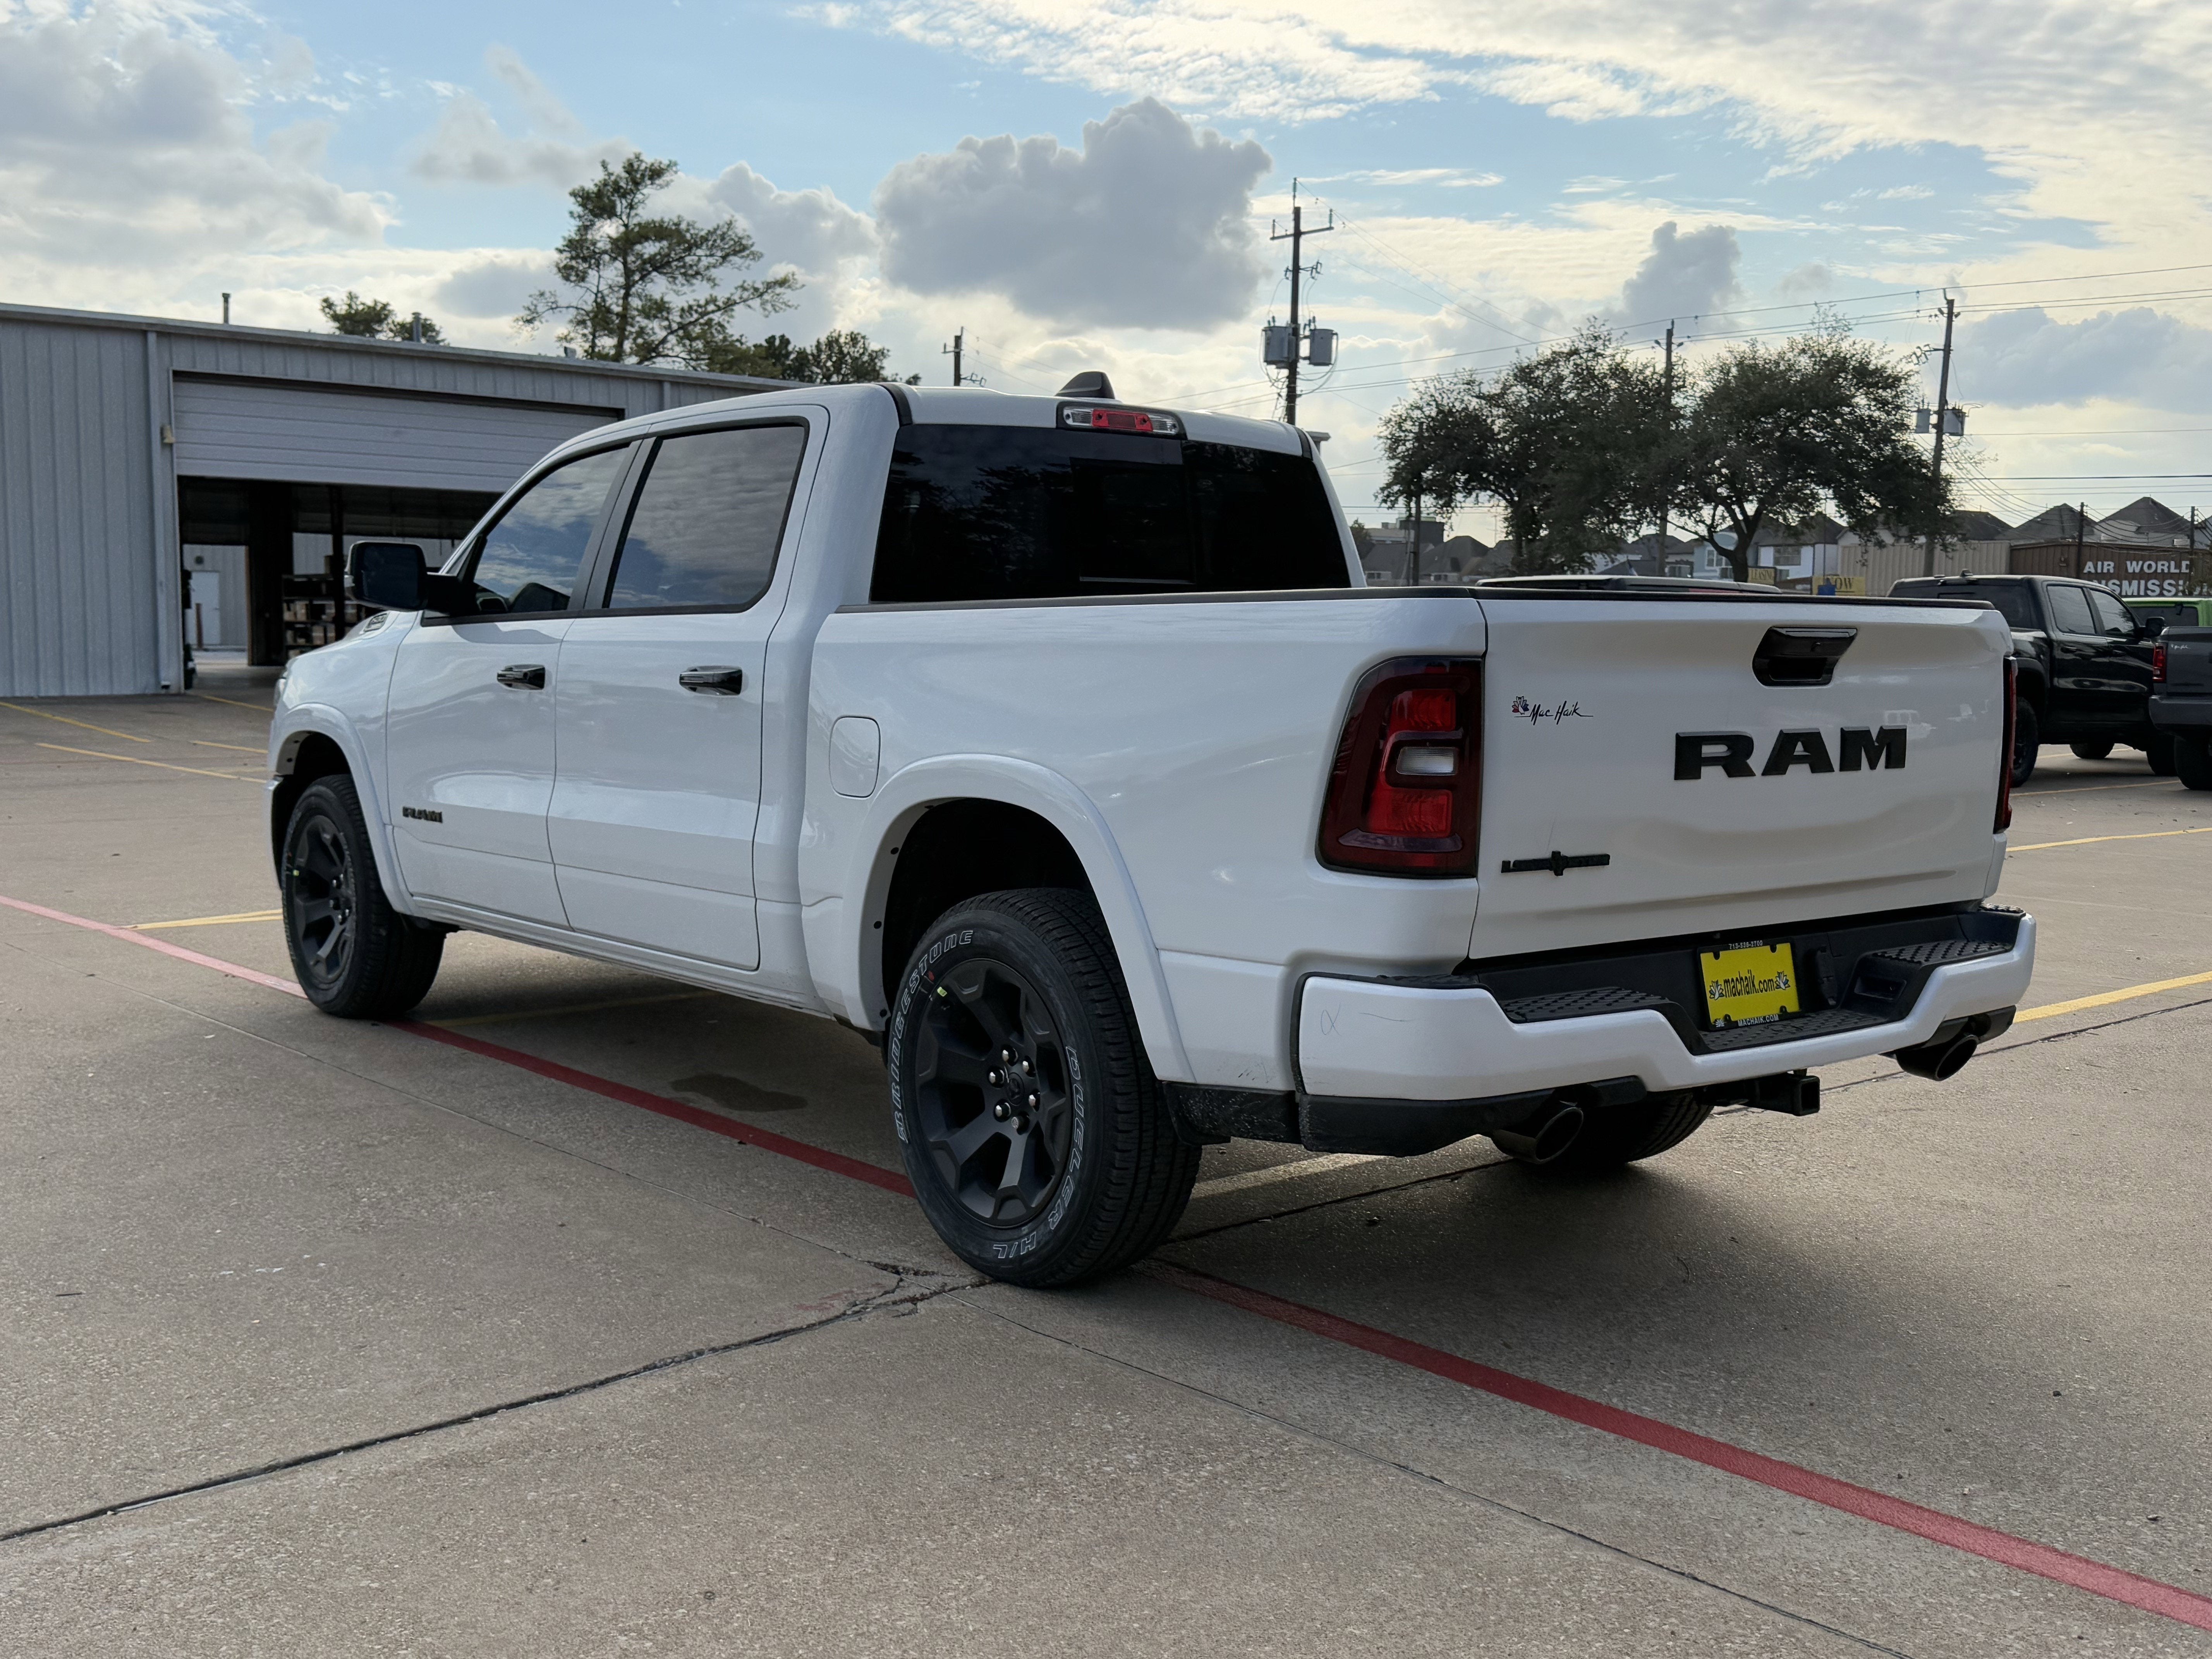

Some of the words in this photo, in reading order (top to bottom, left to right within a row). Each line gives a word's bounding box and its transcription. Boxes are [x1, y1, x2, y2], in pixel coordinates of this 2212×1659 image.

[2083, 561, 2114, 573] AIR
[1530, 704, 1554, 725] Mac
[1554, 700, 1593, 725] Haik
[1674, 725, 1907, 780] RAM
[402, 806, 443, 823] RAM
[1723, 969, 1776, 998] machaik.com
[1738, 1014, 1779, 1026] MACHAIK.COM
[891, 929, 974, 1144] BRIDGESTONE
[1048, 1046, 1084, 1230] DUELER
[993, 1231, 1037, 1259] H/L
